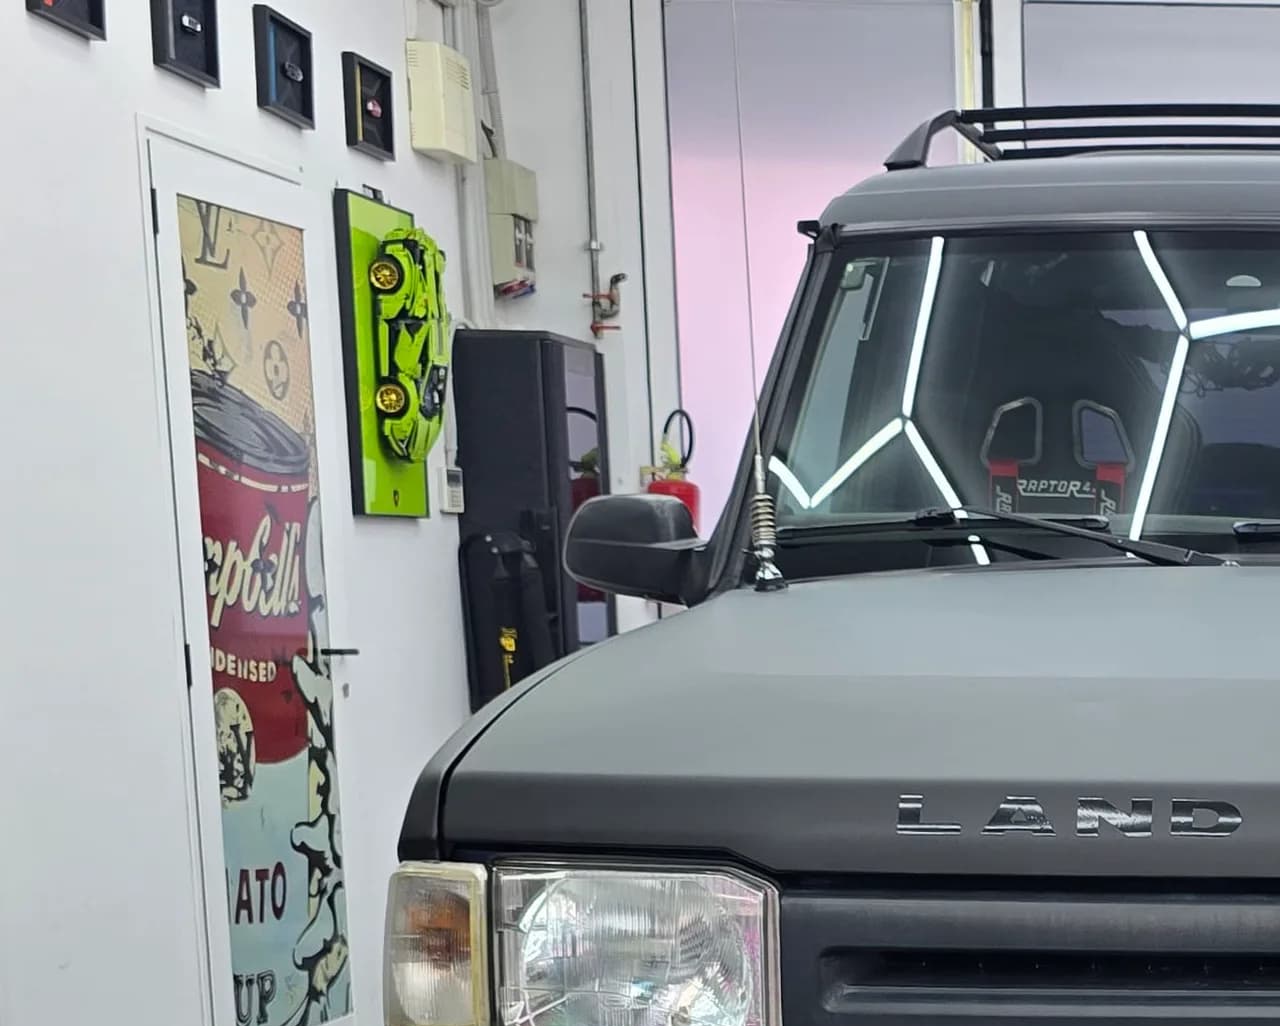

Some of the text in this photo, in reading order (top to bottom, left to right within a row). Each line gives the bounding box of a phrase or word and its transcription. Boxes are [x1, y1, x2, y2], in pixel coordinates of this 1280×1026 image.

[1017, 479, 1081, 498] RAPTOR
[896, 795, 1242, 837] LAND
[226, 862, 287, 925] ATO
